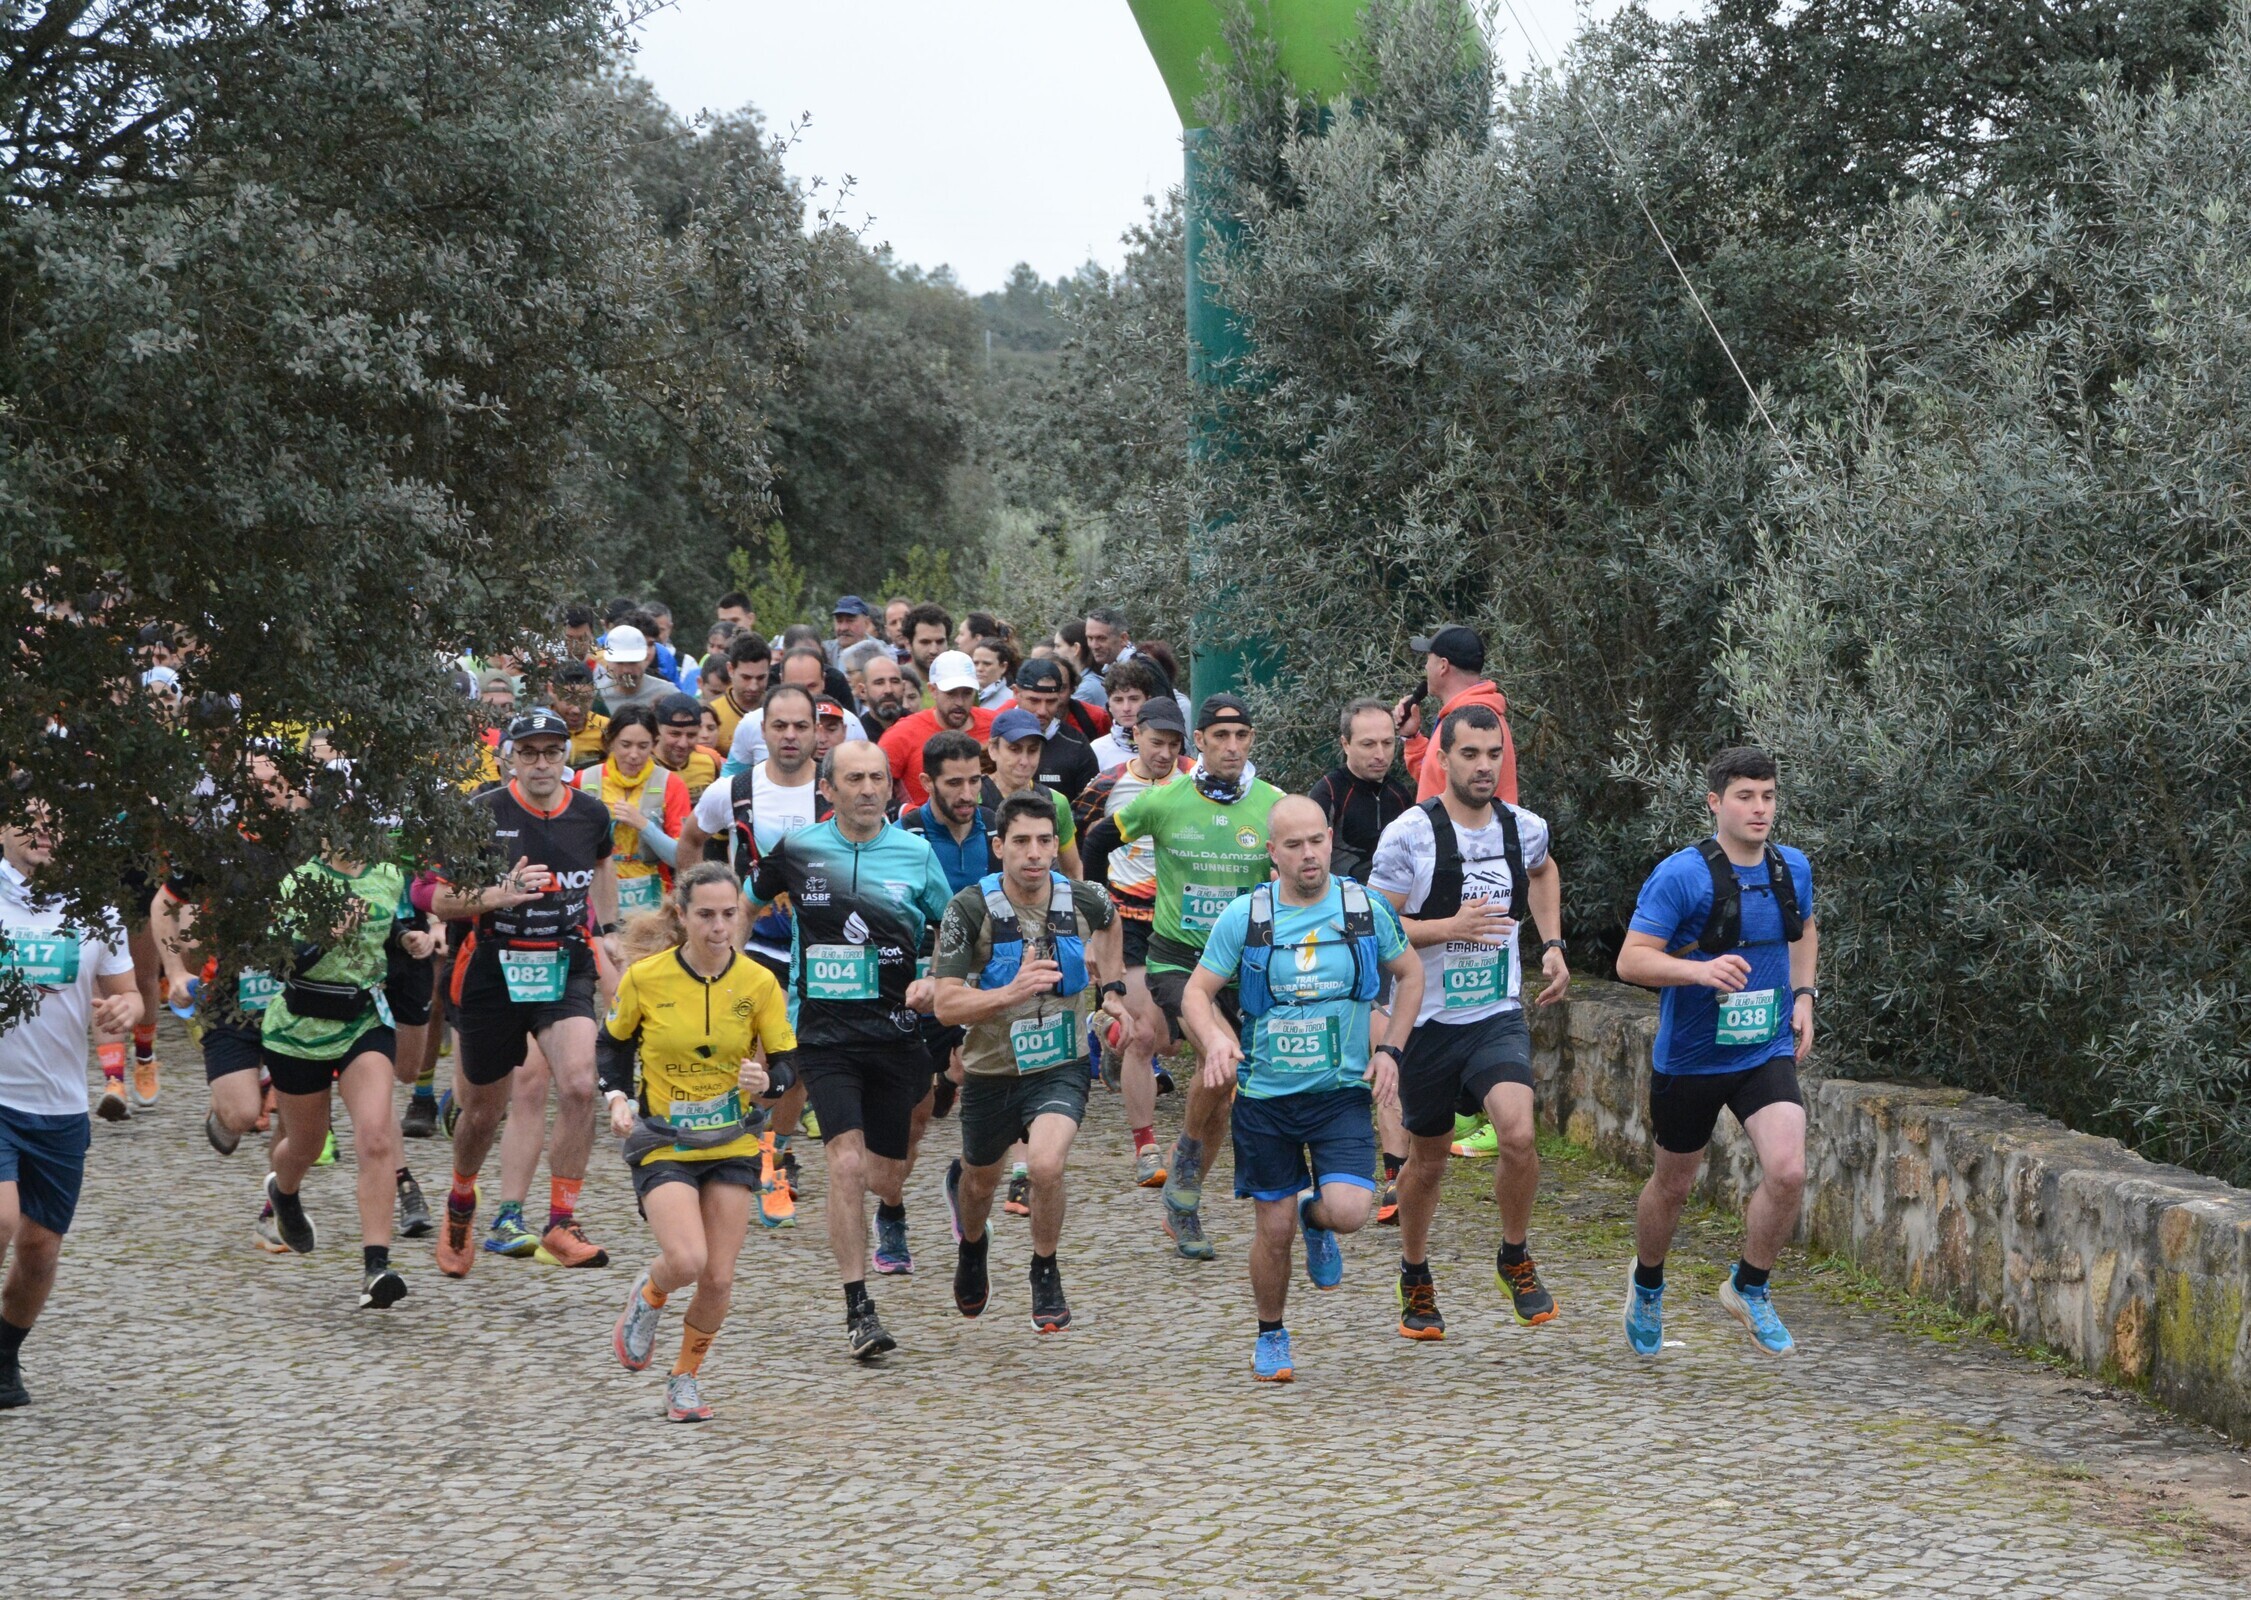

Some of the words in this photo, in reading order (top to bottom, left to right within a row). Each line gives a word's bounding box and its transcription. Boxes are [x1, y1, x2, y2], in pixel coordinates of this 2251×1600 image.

[1167, 847, 1199, 858] TRAIL
[1201, 851, 1218, 859] DA
[1193, 862, 1250, 874] RUNNER'S
[507, 966, 549, 983] 082
[814, 962, 857, 980] 004
[1296, 975, 1319, 984] TRAIL
[1451, 969, 1492, 989] 032
[1300, 983, 1313, 991] DA
[1727, 1007, 1767, 1028] 038
[1283, 1025, 1299, 1034] OLHO
[1305, 1022, 1325, 1033] TORDO
[1015, 1032, 1054, 1053] 001
[1276, 1035, 1321, 1054] 025
